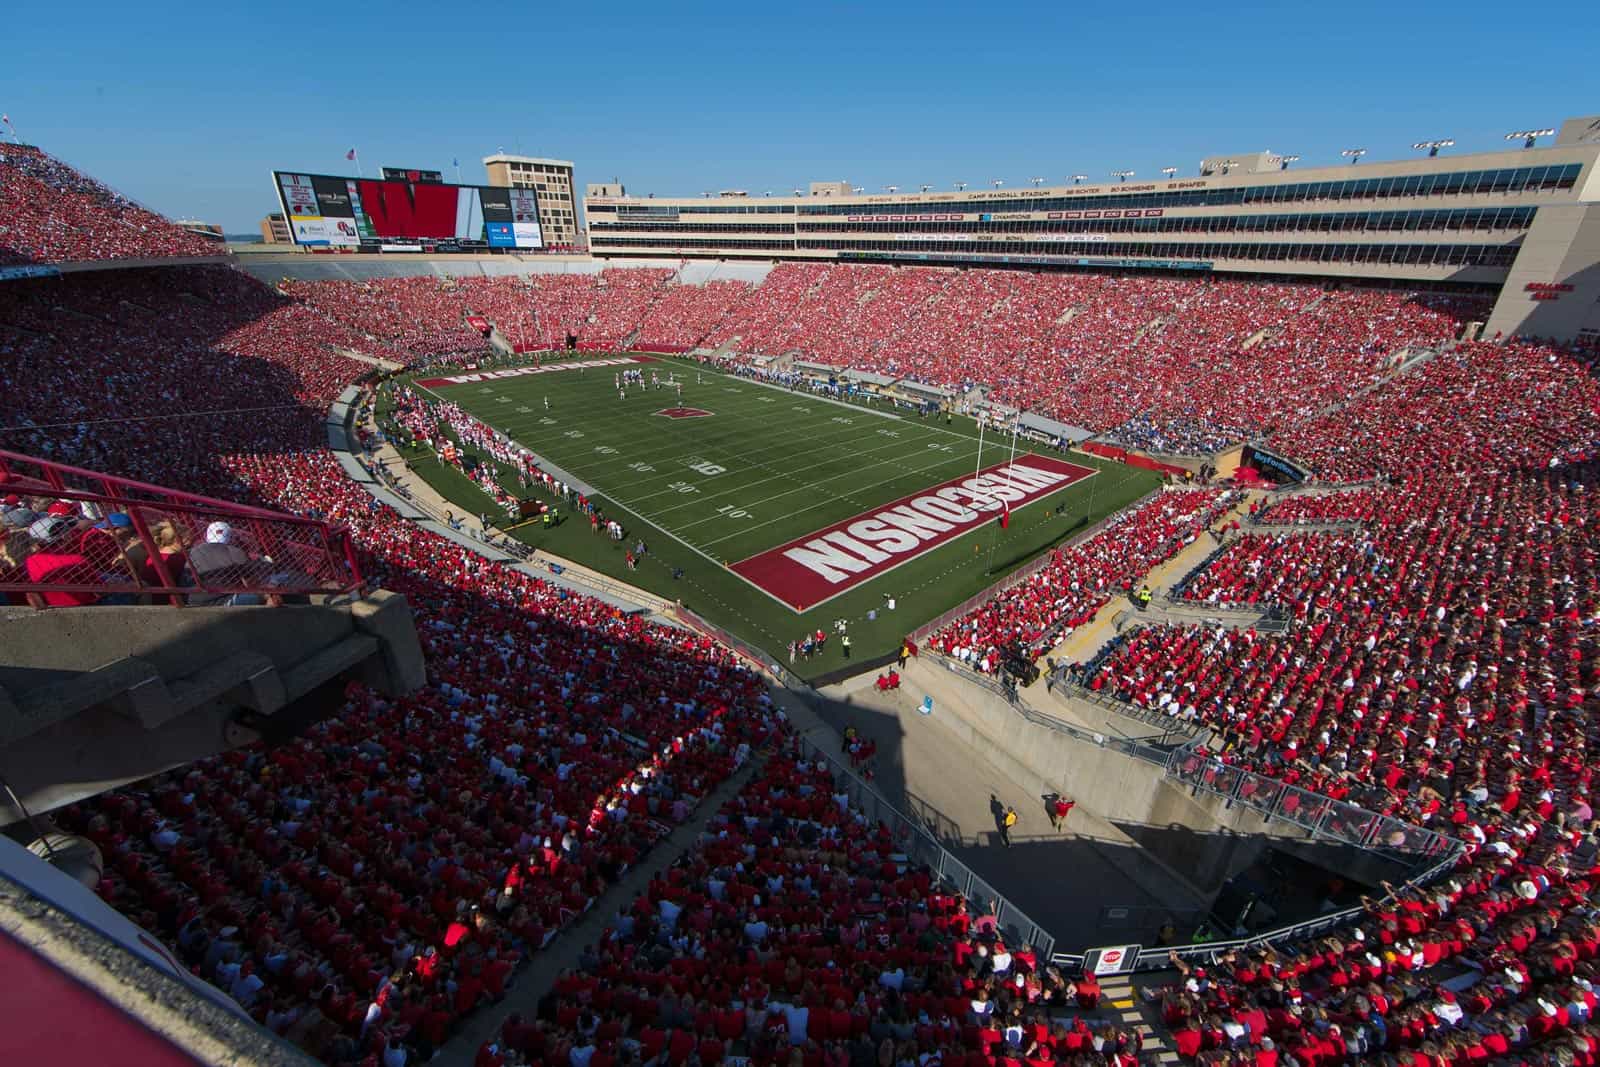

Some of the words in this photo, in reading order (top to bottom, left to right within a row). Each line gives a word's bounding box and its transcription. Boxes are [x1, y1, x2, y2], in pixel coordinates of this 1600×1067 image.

[444, 358, 640, 384] WISCONSIN
[716, 504, 747, 519] 10
[782, 464, 1070, 584] WISCONSIN
